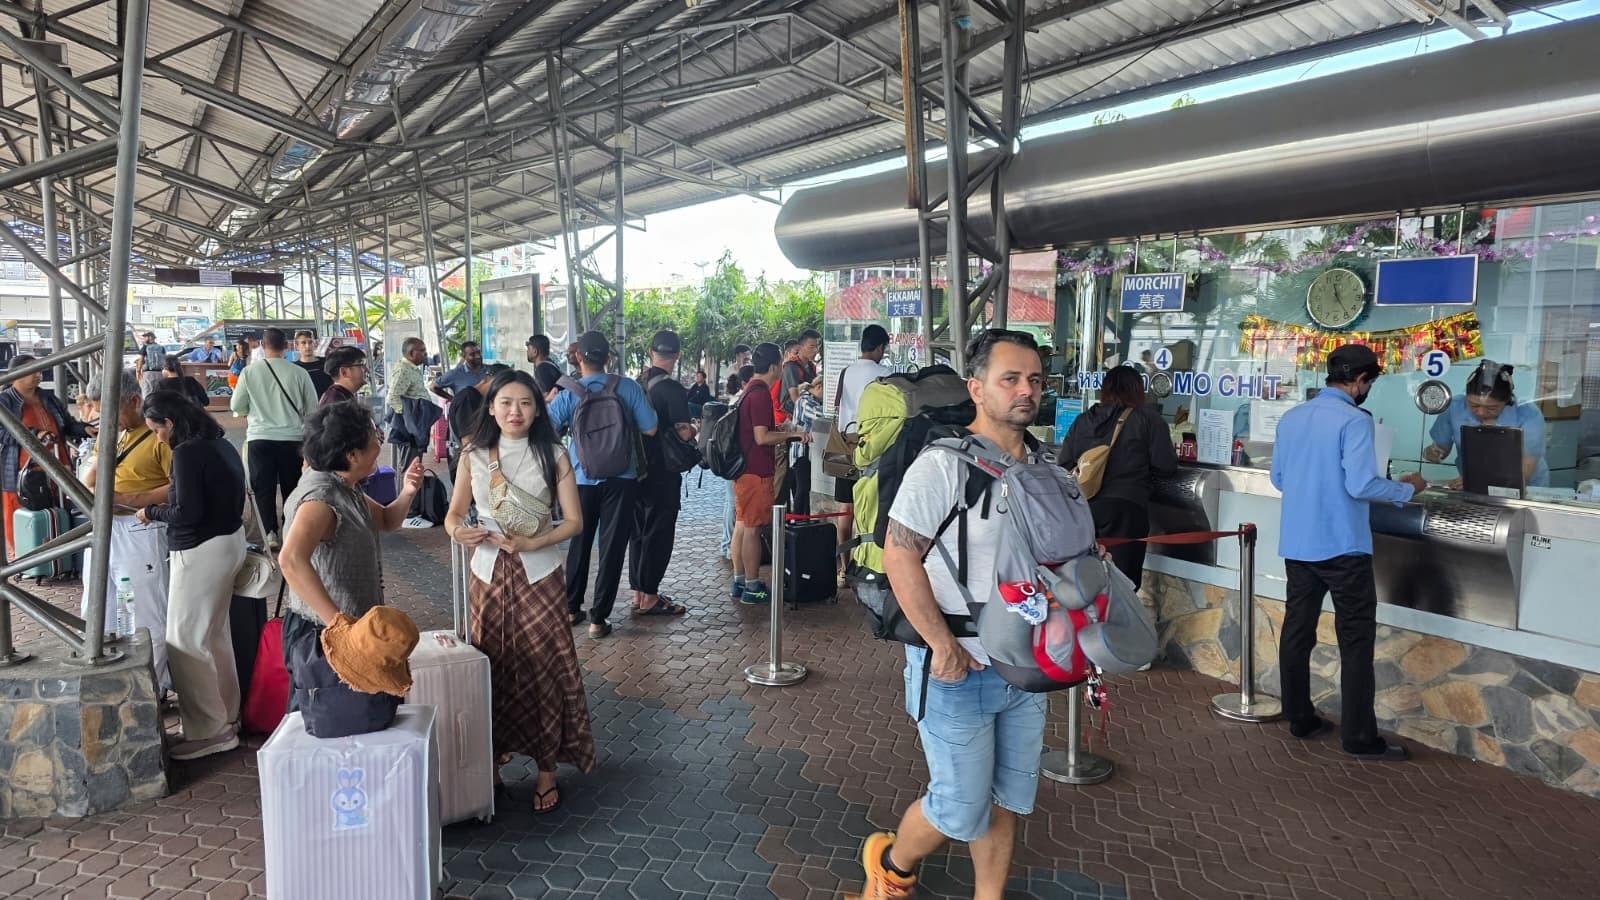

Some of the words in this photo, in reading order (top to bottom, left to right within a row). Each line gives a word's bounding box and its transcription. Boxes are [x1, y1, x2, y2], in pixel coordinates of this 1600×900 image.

[1125, 276, 1181, 291] MORCHIT
[889, 290, 920, 302] EKKAMAI
[1138, 293, 1165, 309] 莫奇
[889, 333, 924, 345] BANGK
[910, 347, 917, 362] 3
[1156, 350, 1168, 367] 4
[1427, 353, 1443, 376] 5
[1173, 372, 1212, 396] MO
[1218, 374, 1282, 399] CHIT
